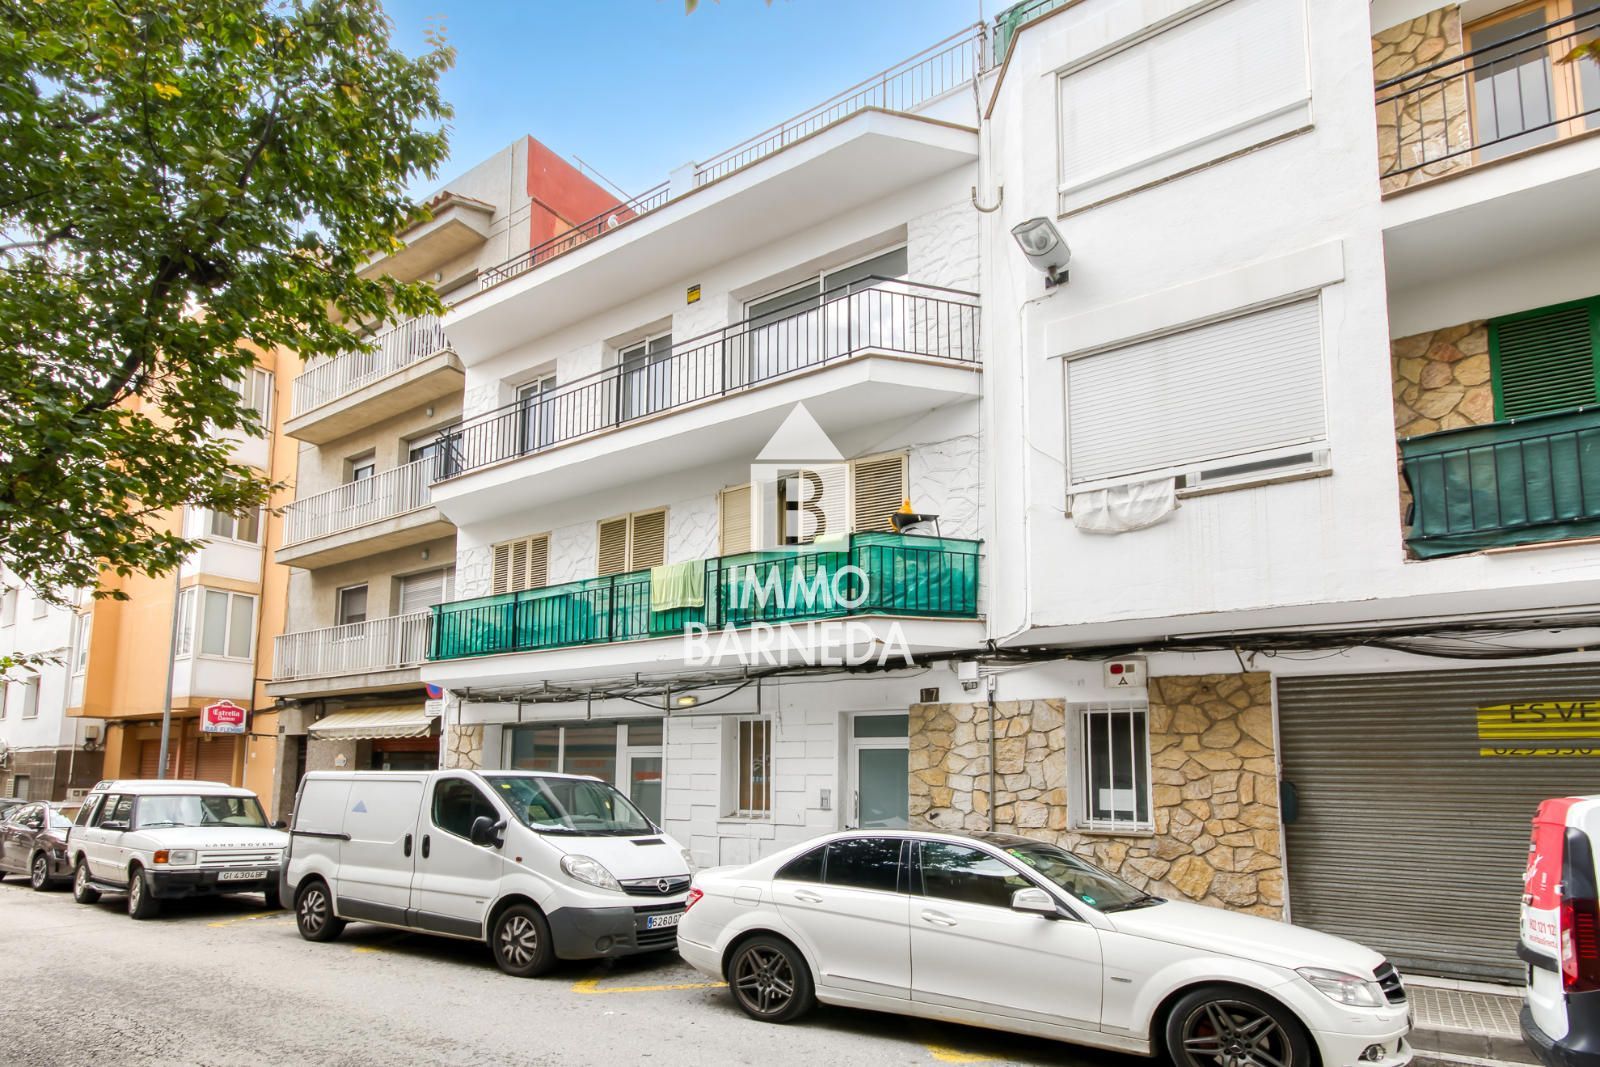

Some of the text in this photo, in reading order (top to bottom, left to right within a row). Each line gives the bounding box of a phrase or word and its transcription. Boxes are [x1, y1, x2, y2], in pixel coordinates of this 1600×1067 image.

[922, 689, 937, 702] 17
[212, 709, 240, 717] Estrella
[1510, 703, 1547, 723] ES
